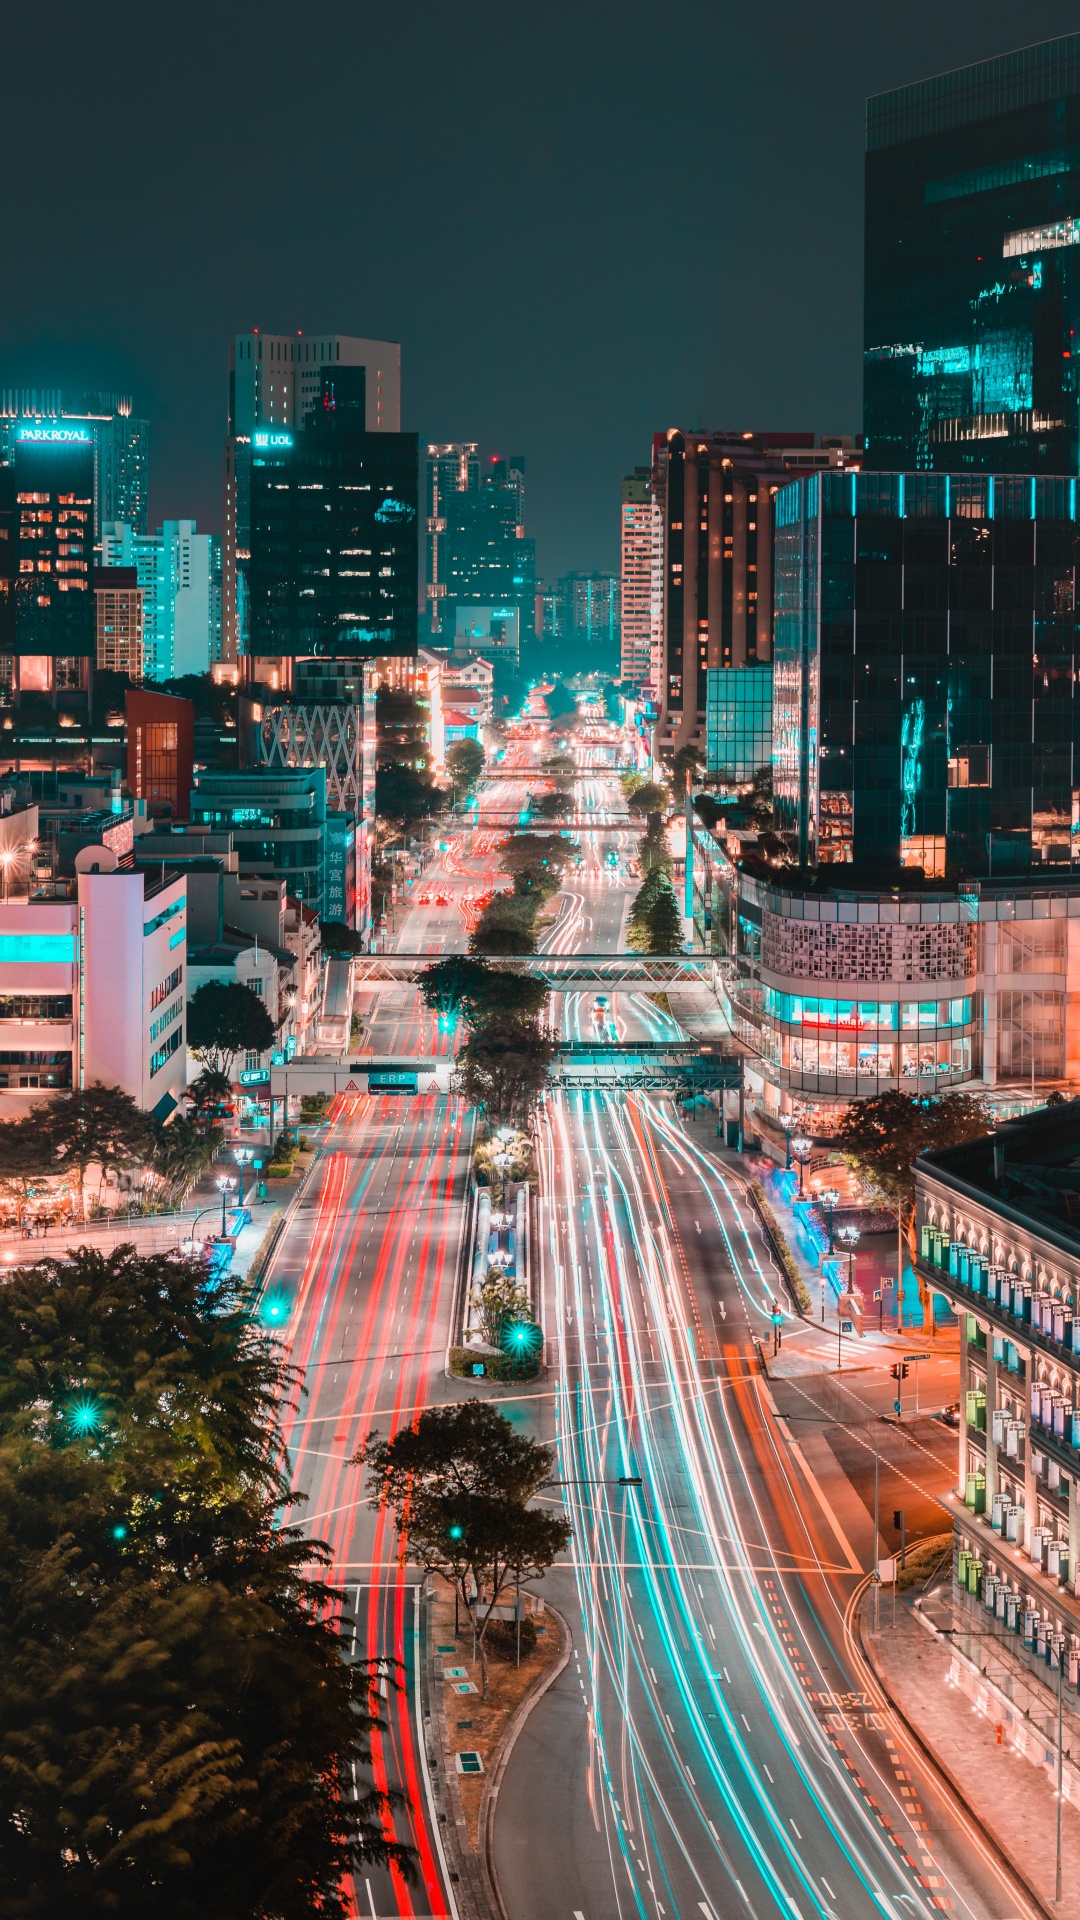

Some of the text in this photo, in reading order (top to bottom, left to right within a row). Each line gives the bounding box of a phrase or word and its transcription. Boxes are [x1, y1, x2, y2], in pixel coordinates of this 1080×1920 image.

[20, 429, 89, 441] PARKROYAL
[270, 435, 292, 445] UOL
[328, 851, 343, 916] 华宫旅游
[380, 1074, 406, 1083] ERP
[818, 1692, 873, 1706] 23:00
[829, 1713, 886, 1731] 07:30
